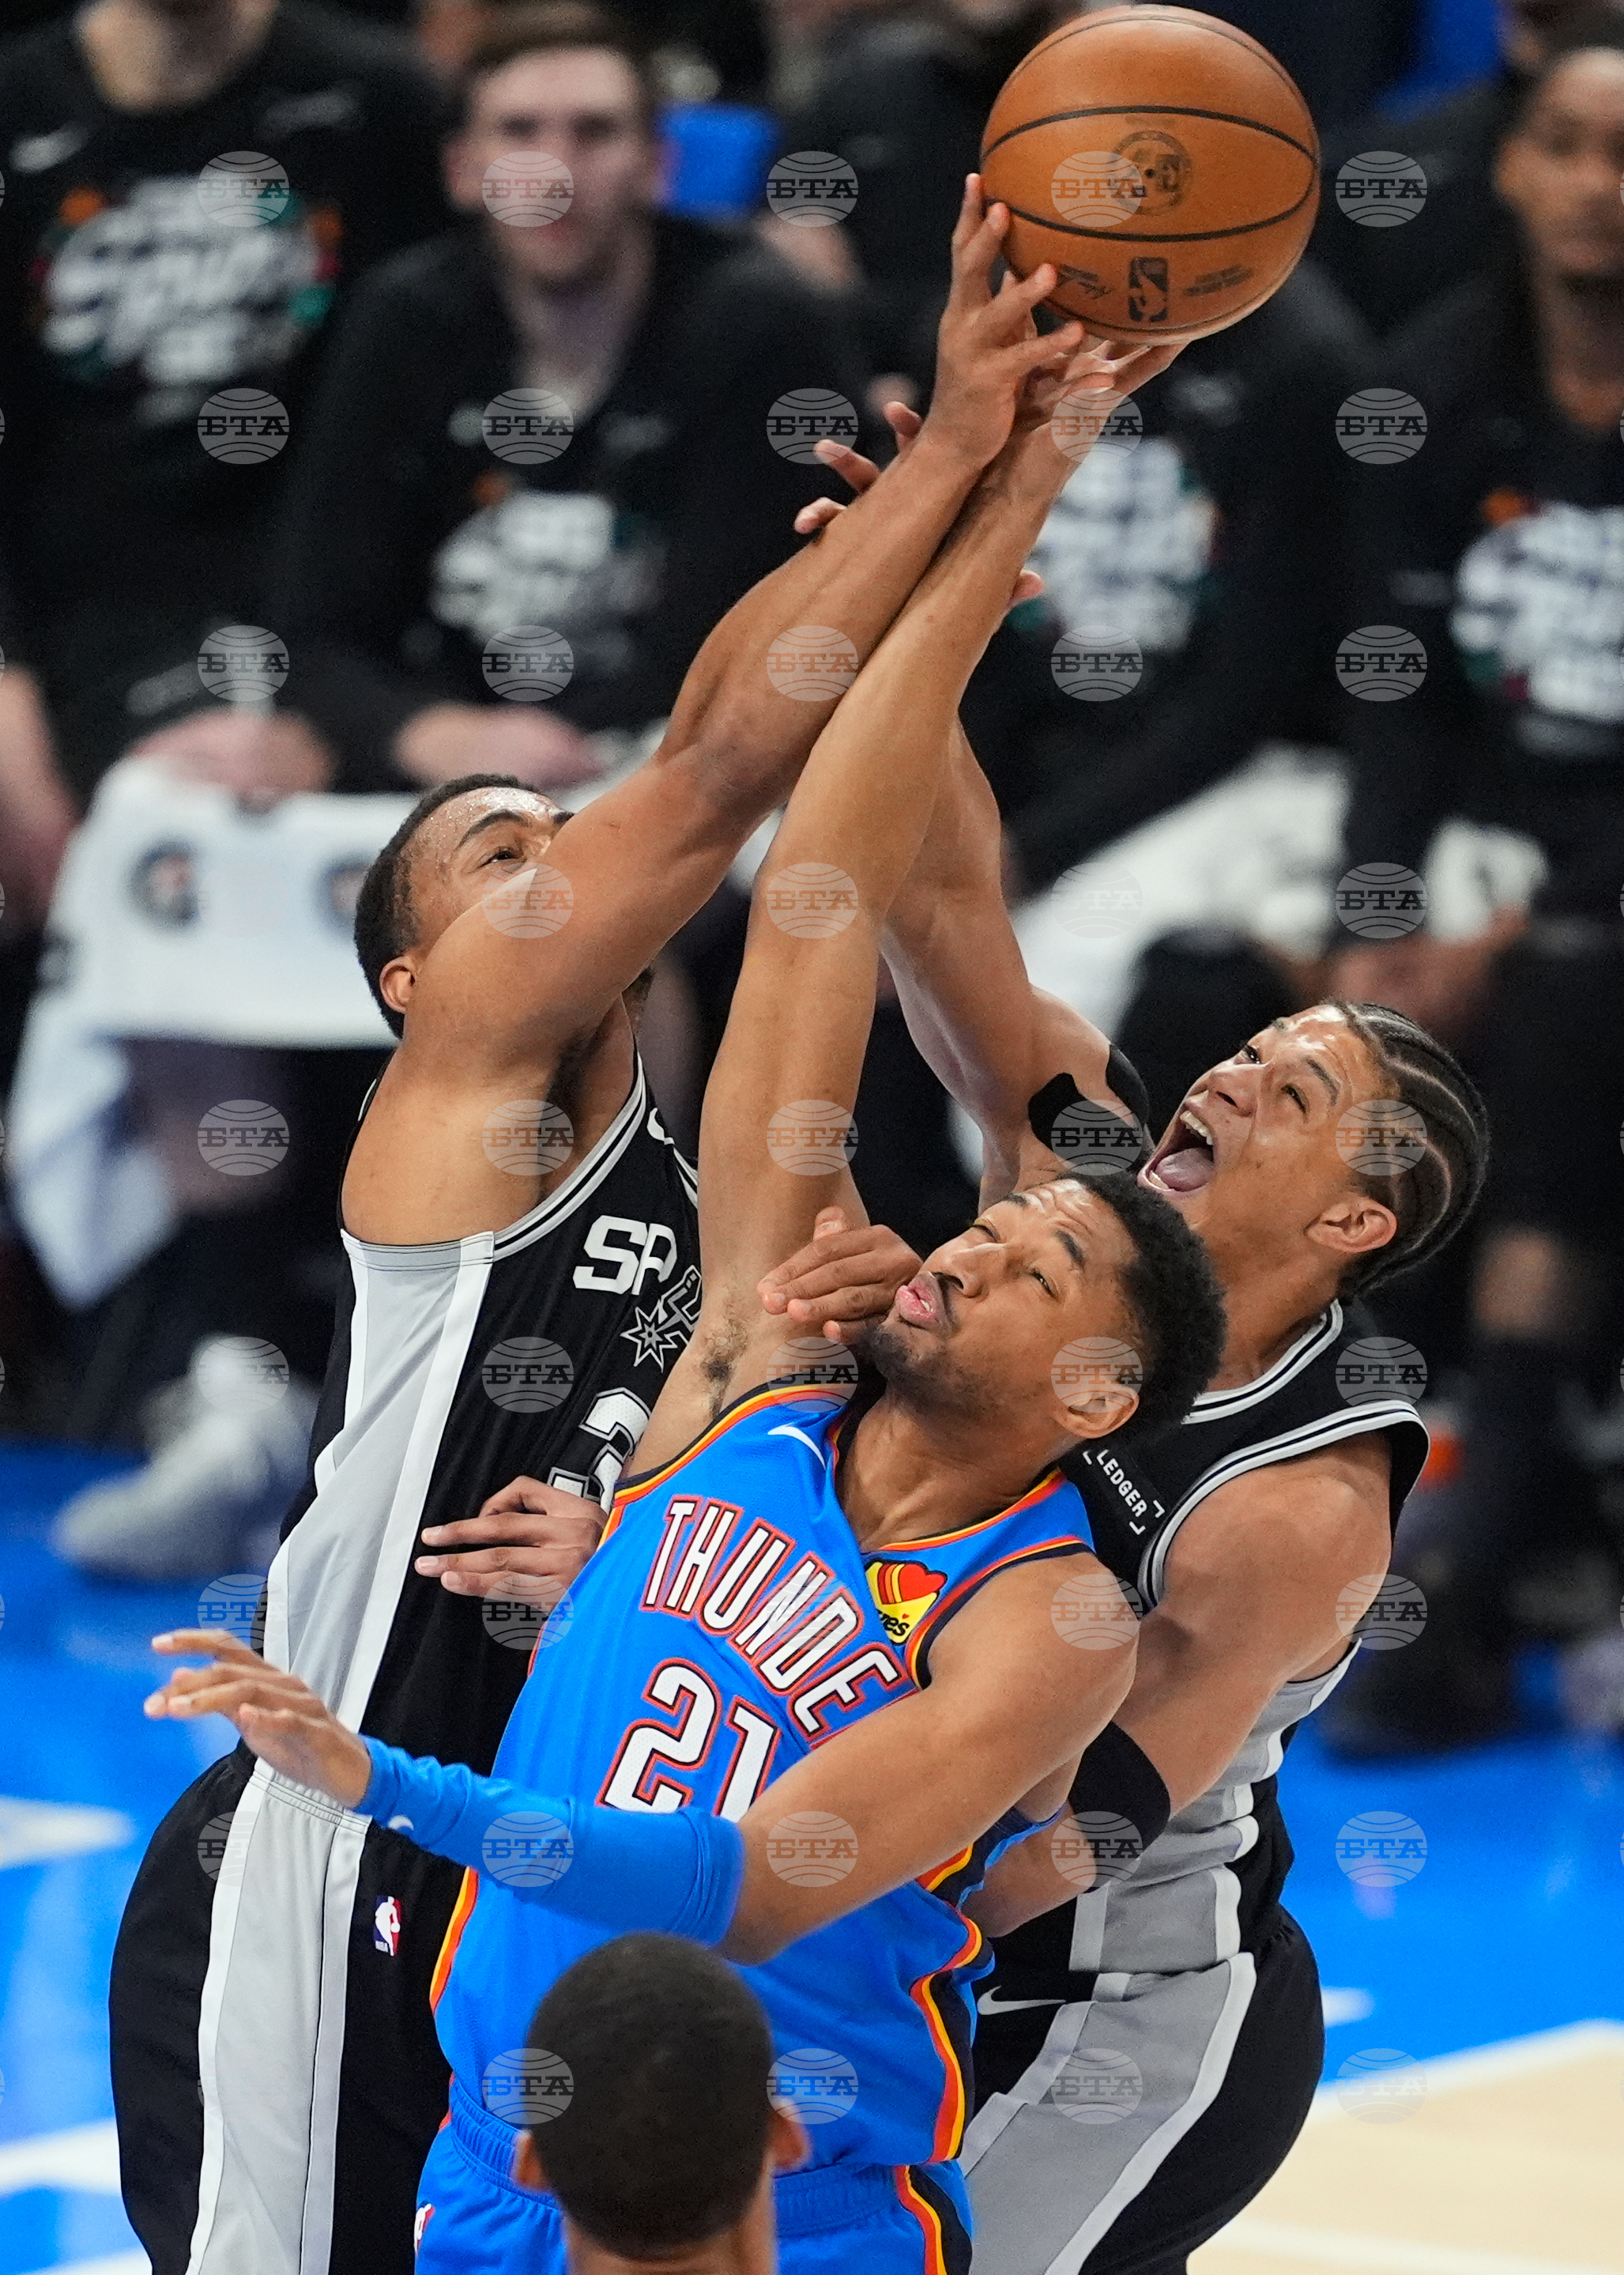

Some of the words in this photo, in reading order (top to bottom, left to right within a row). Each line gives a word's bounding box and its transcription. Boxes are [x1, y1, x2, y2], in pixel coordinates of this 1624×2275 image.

[1096, 1449, 1147, 1518] LEDGER
[642, 1495, 909, 1743] THUNDE
[597, 1658, 782, 1821] 21
